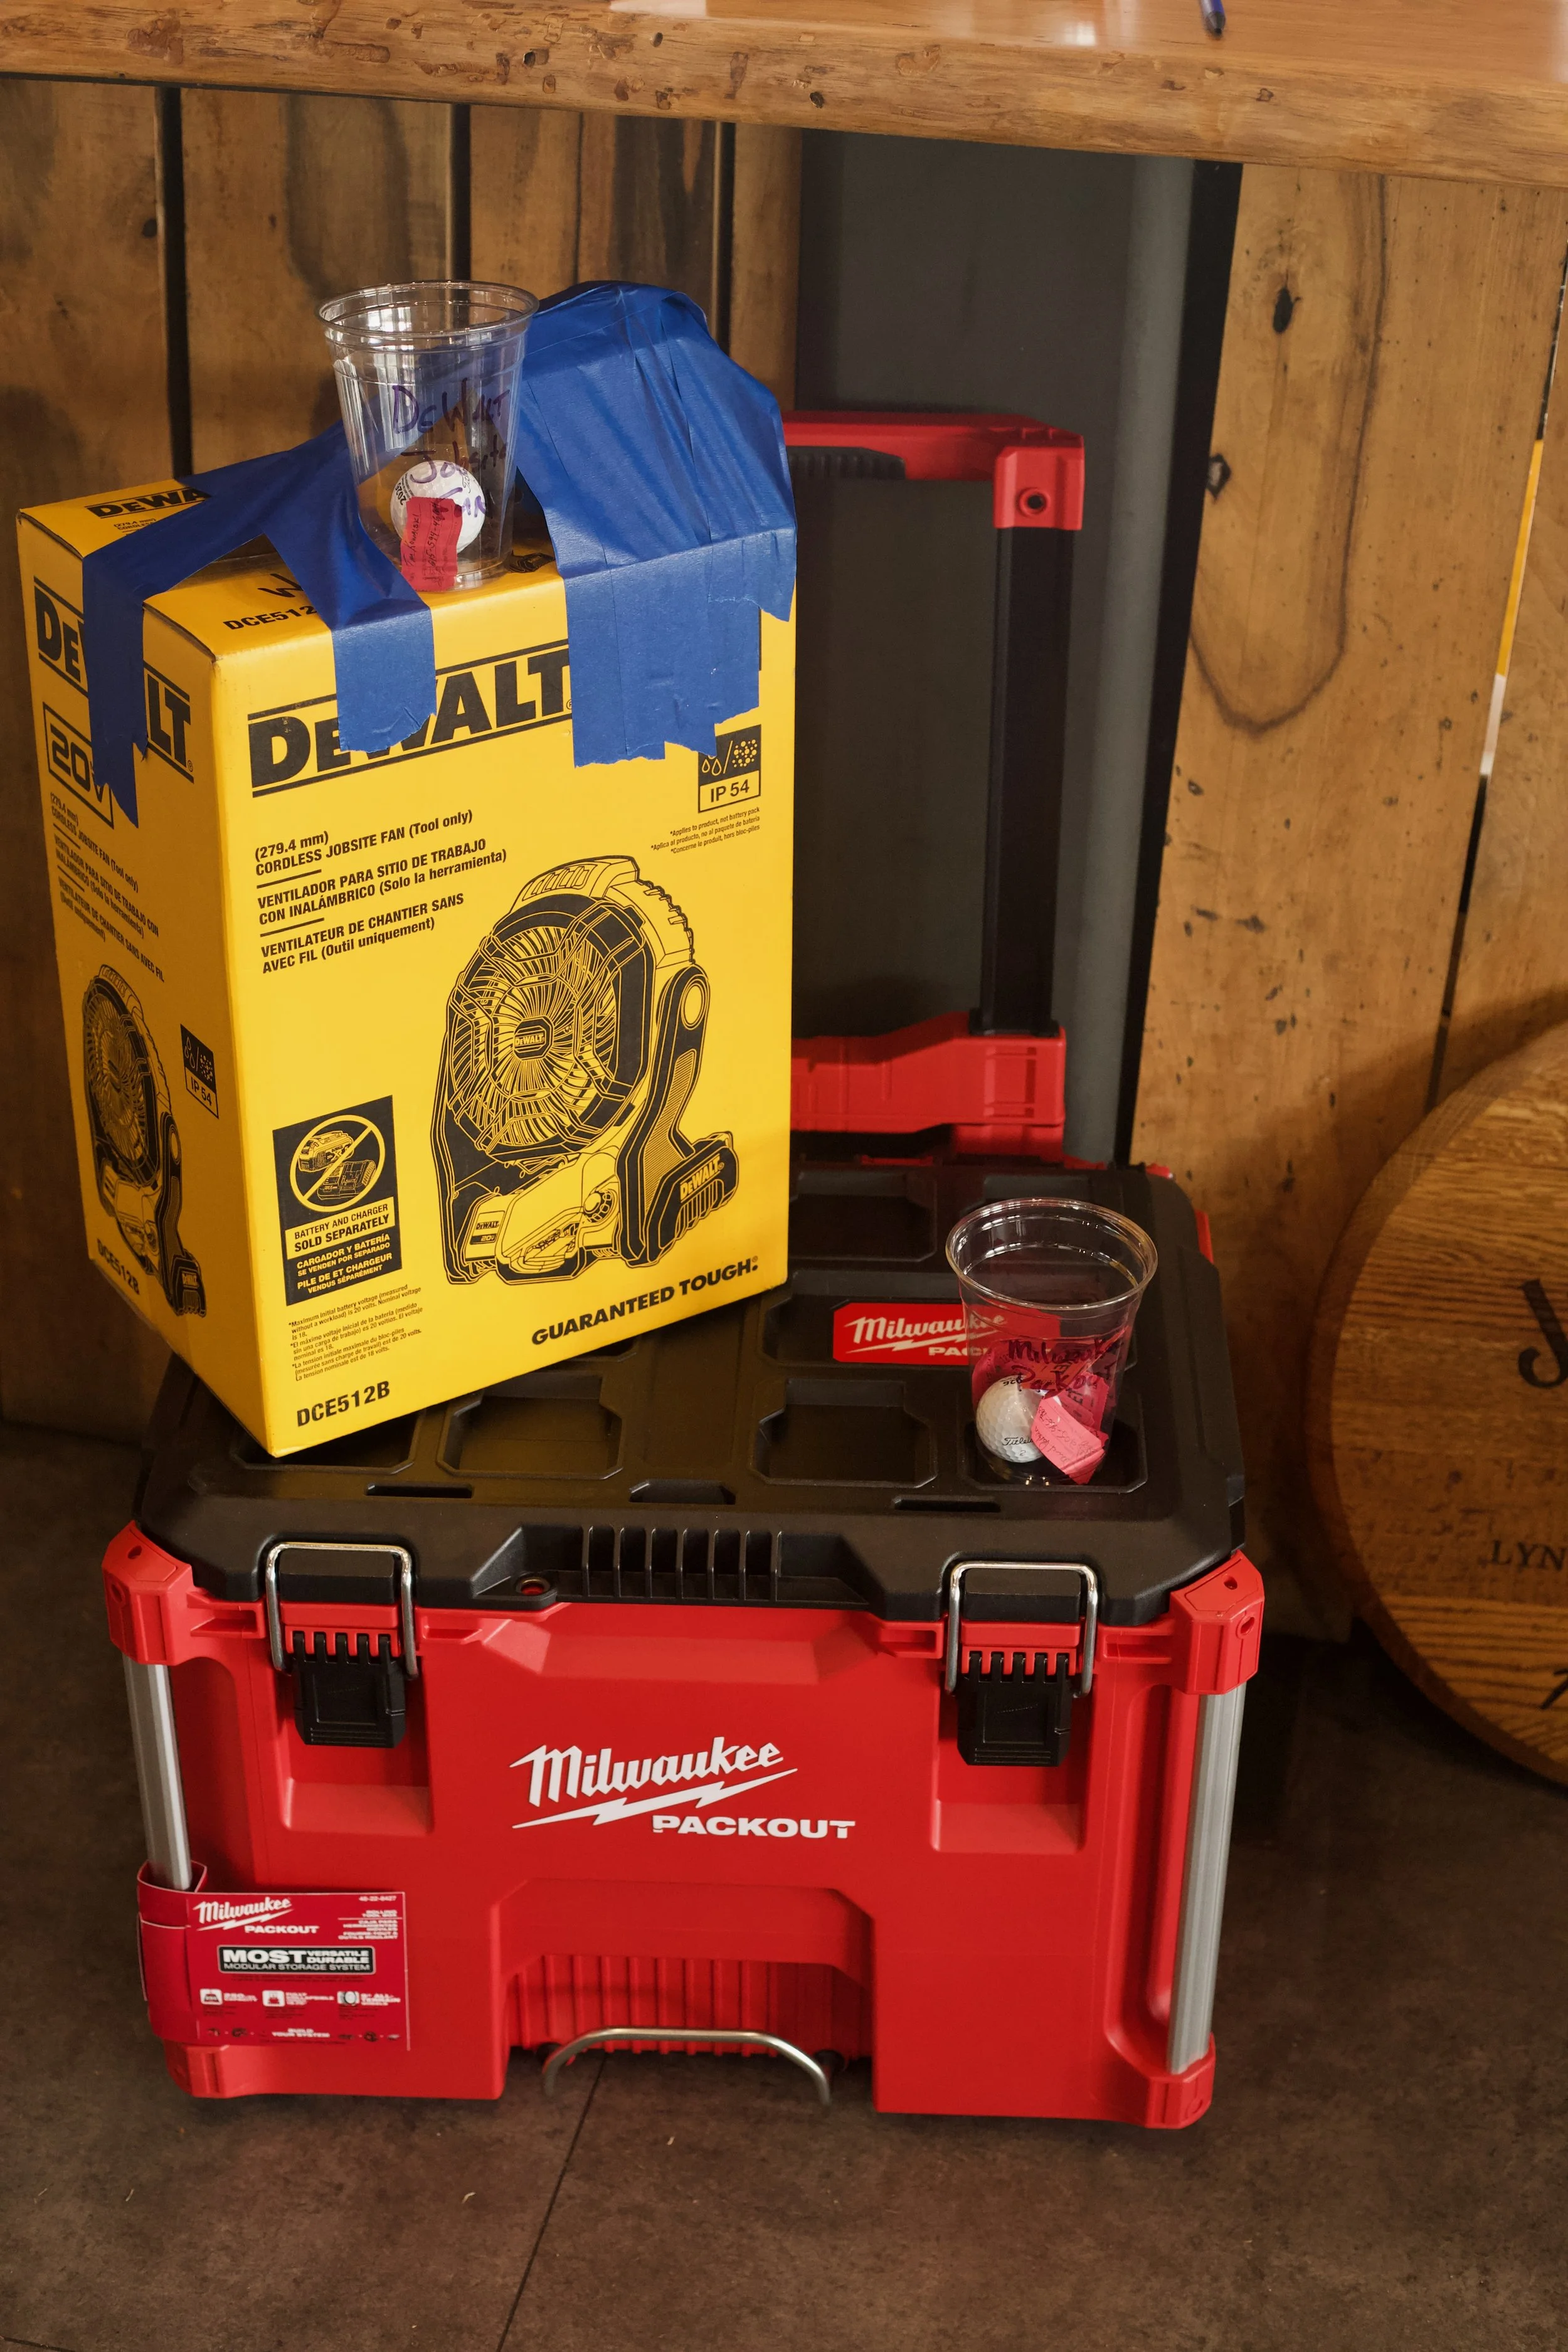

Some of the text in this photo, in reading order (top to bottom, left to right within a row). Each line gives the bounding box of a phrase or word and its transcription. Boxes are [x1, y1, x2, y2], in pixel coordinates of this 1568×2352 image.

[87, 488, 211, 517] DEWA
[223, 605, 317, 630] DCE512
[34, 586, 191, 768] DELT
[248, 649, 569, 788] DEALT
[710, 778, 750, 803] IP 54
[255, 809, 473, 876] CORDLESS JOBSITE FAN (Tool only)
[255, 830, 329, 862] (279.4 mm)
[257, 838, 486, 909] VENTILADOR PARA SITIO DE TRABAJO
[258, 848, 507, 925] CON INALÁMBRICO (Solo la herramienta)
[260, 893, 464, 958] VENTILATEUR DE CHANTIER SANS
[262, 916, 435, 974] AVEC FIL (Outil uniquement)
[294, 1203, 388, 1240] BATTERY AND CHARGER
[294, 1213, 389, 1253] SOLD SEPARATELY
[296, 1248, 345, 1271] CARGADOR
[346, 1245, 352, 1253] Y
[297, 1241, 390, 1277] SE VENDEN POR SEPARADO
[297, 1252, 393, 1290] PILE DE ET CHARGEUR
[307, 1279, 336, 1294] VENDUS
[531, 1286, 675, 1345] GUARANTEED
[296, 1380, 390, 1427] DCE512B
[510, 1737, 783, 1807] Milwaukee
[652, 1814, 856, 1839] PACKOUT
[193, 1896, 292, 1924] Milwaukee
[244, 1925, 320, 1934] PACKOUT
[223, 1949, 307, 1964] MOST
